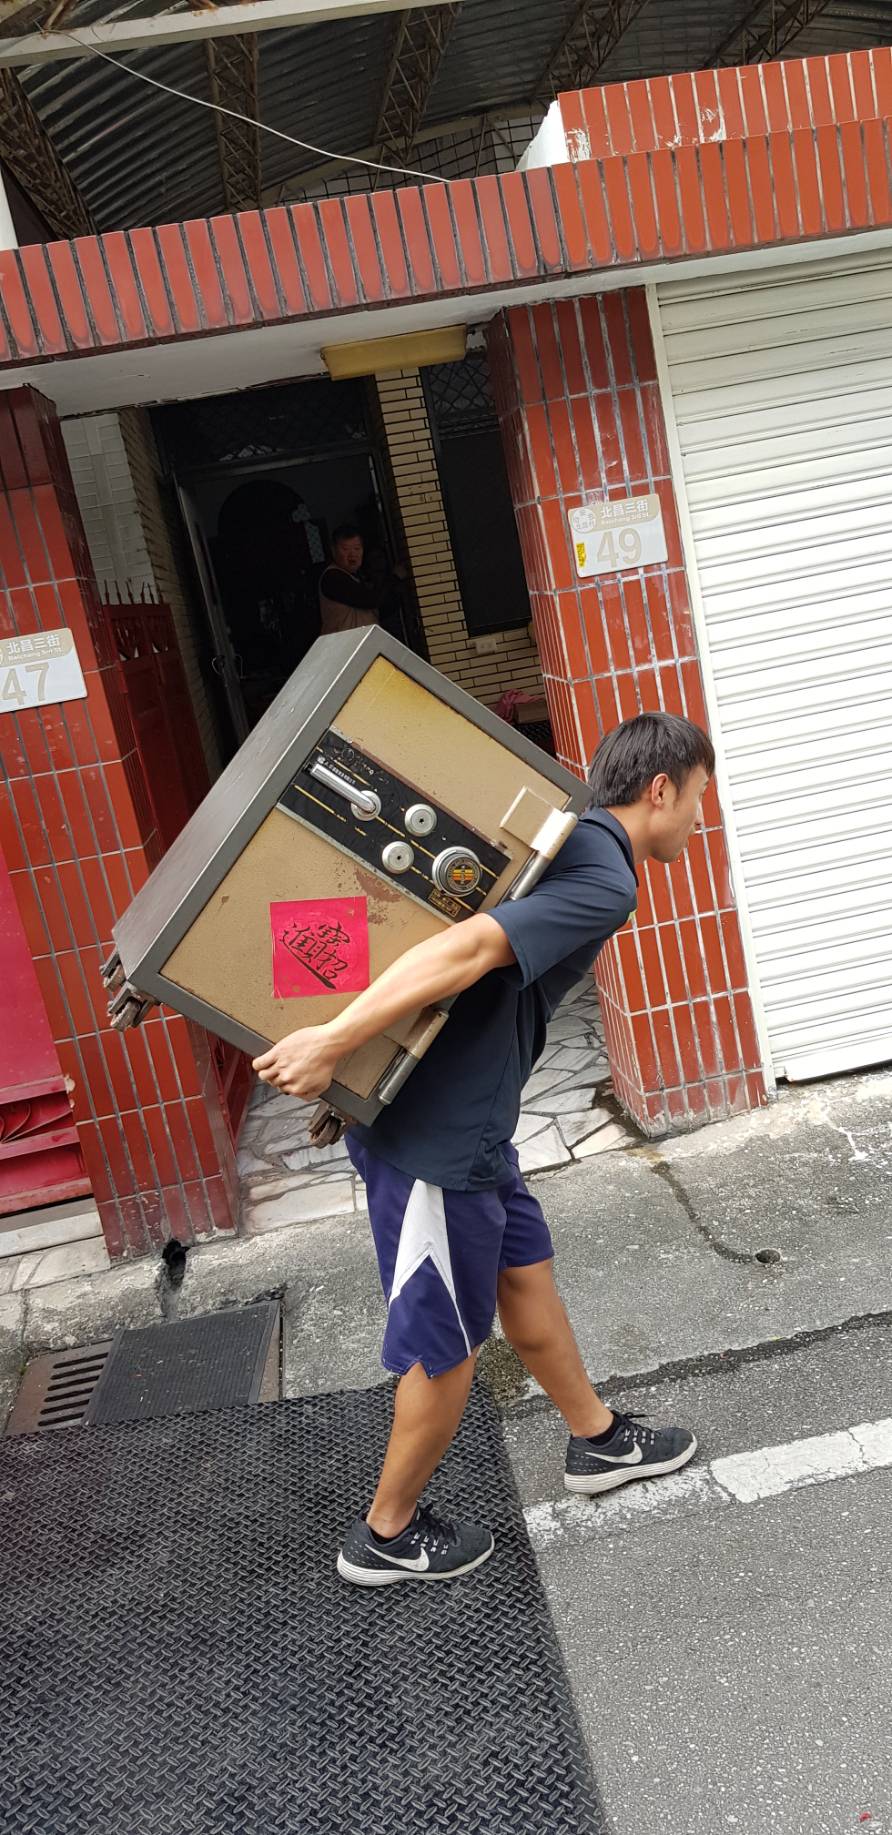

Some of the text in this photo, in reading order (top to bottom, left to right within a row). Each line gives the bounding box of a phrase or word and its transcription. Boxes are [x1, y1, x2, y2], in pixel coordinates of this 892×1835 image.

[601, 498, 648, 519] 北昌三街
[597, 528, 641, 568] 49
[7, 633, 60, 655] 北昌三街
[2, 662, 49, 706] 47
